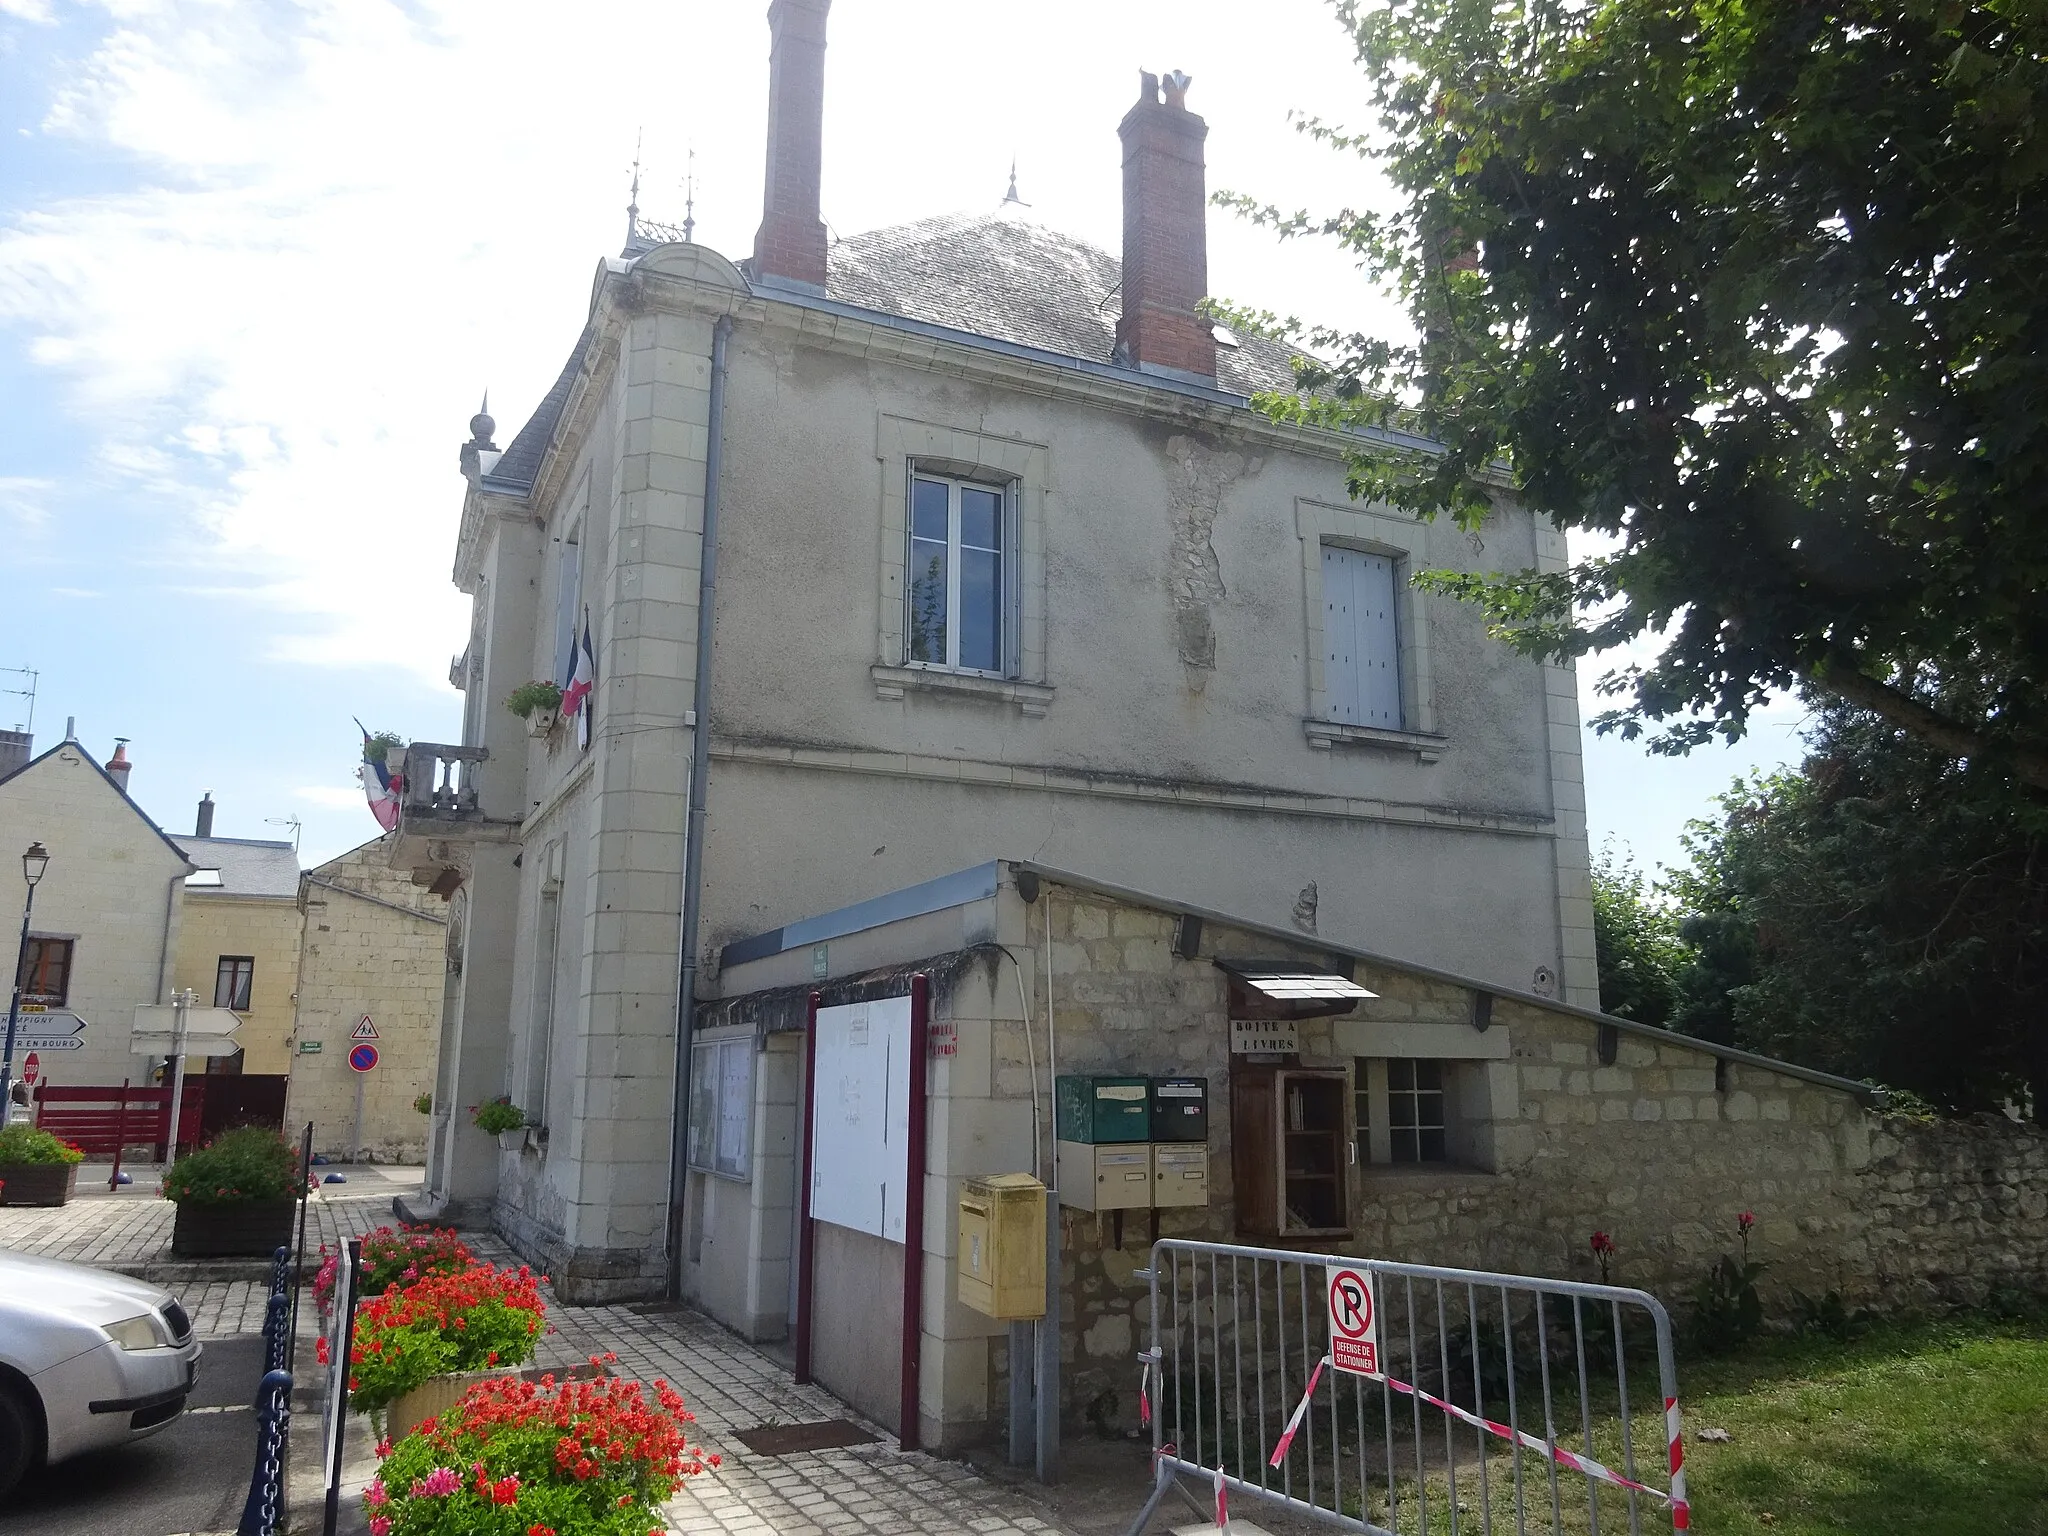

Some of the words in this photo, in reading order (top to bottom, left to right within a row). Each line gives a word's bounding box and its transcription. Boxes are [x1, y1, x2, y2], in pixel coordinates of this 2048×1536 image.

[1236, 1022, 1279, 1032] BOITE
[1243, 1039, 1294, 1050] LIVRES
[1336, 1341, 1361, 1355] DEFENSE
[1361, 1345, 1370, 1356] DE
[1336, 1353, 1373, 1370] STATIONNER
